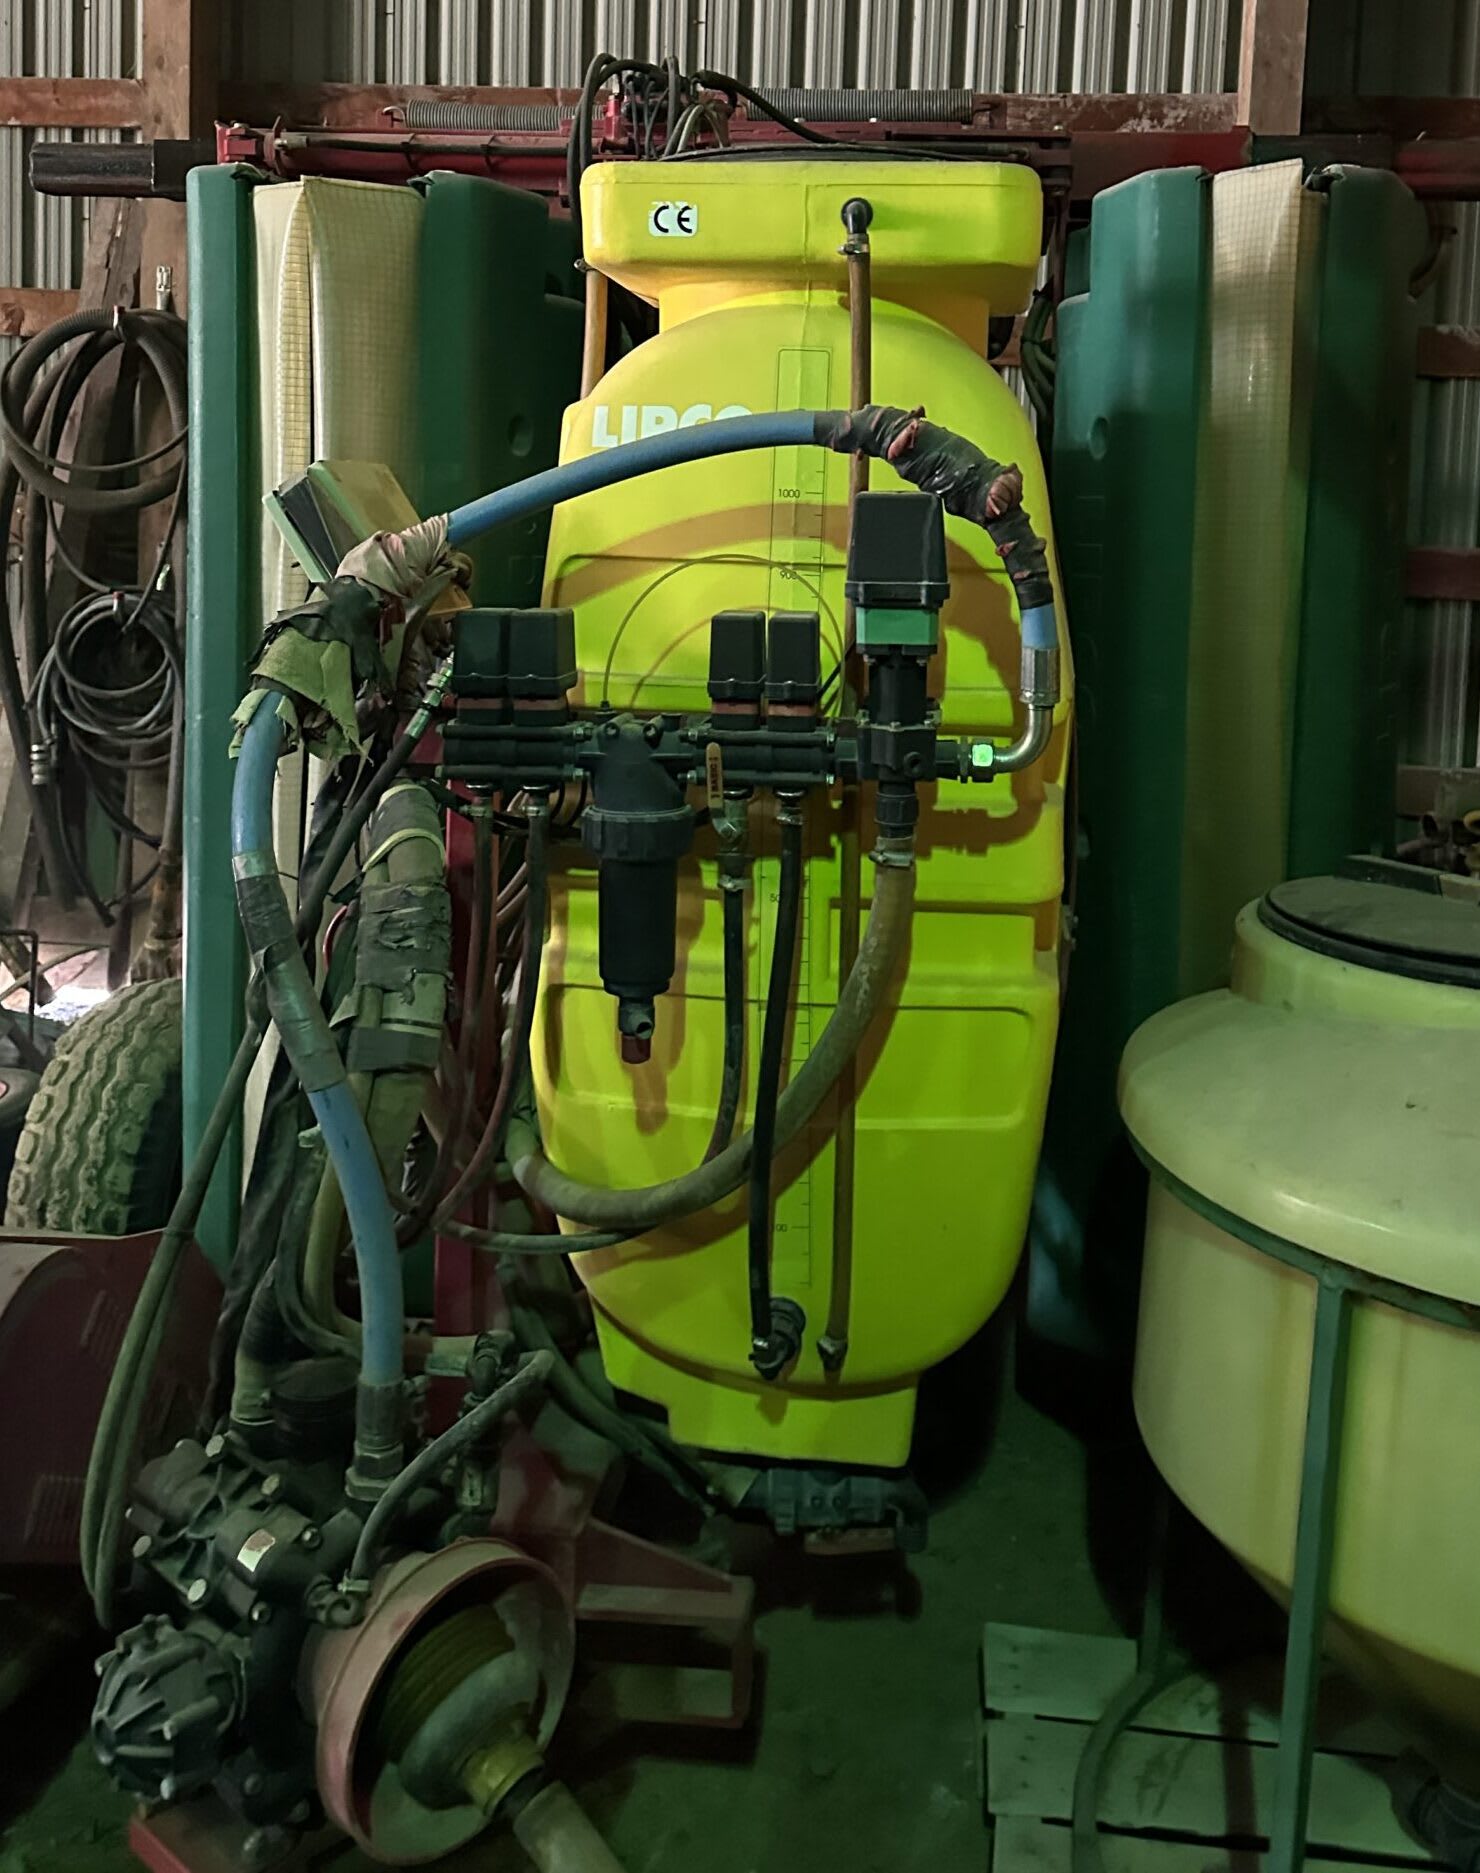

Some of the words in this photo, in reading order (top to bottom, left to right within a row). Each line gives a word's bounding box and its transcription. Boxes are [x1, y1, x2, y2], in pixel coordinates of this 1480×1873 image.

[653, 204, 693, 234] CE
[778, 488, 801, 499] 1000
[779, 569, 800, 580] 900
